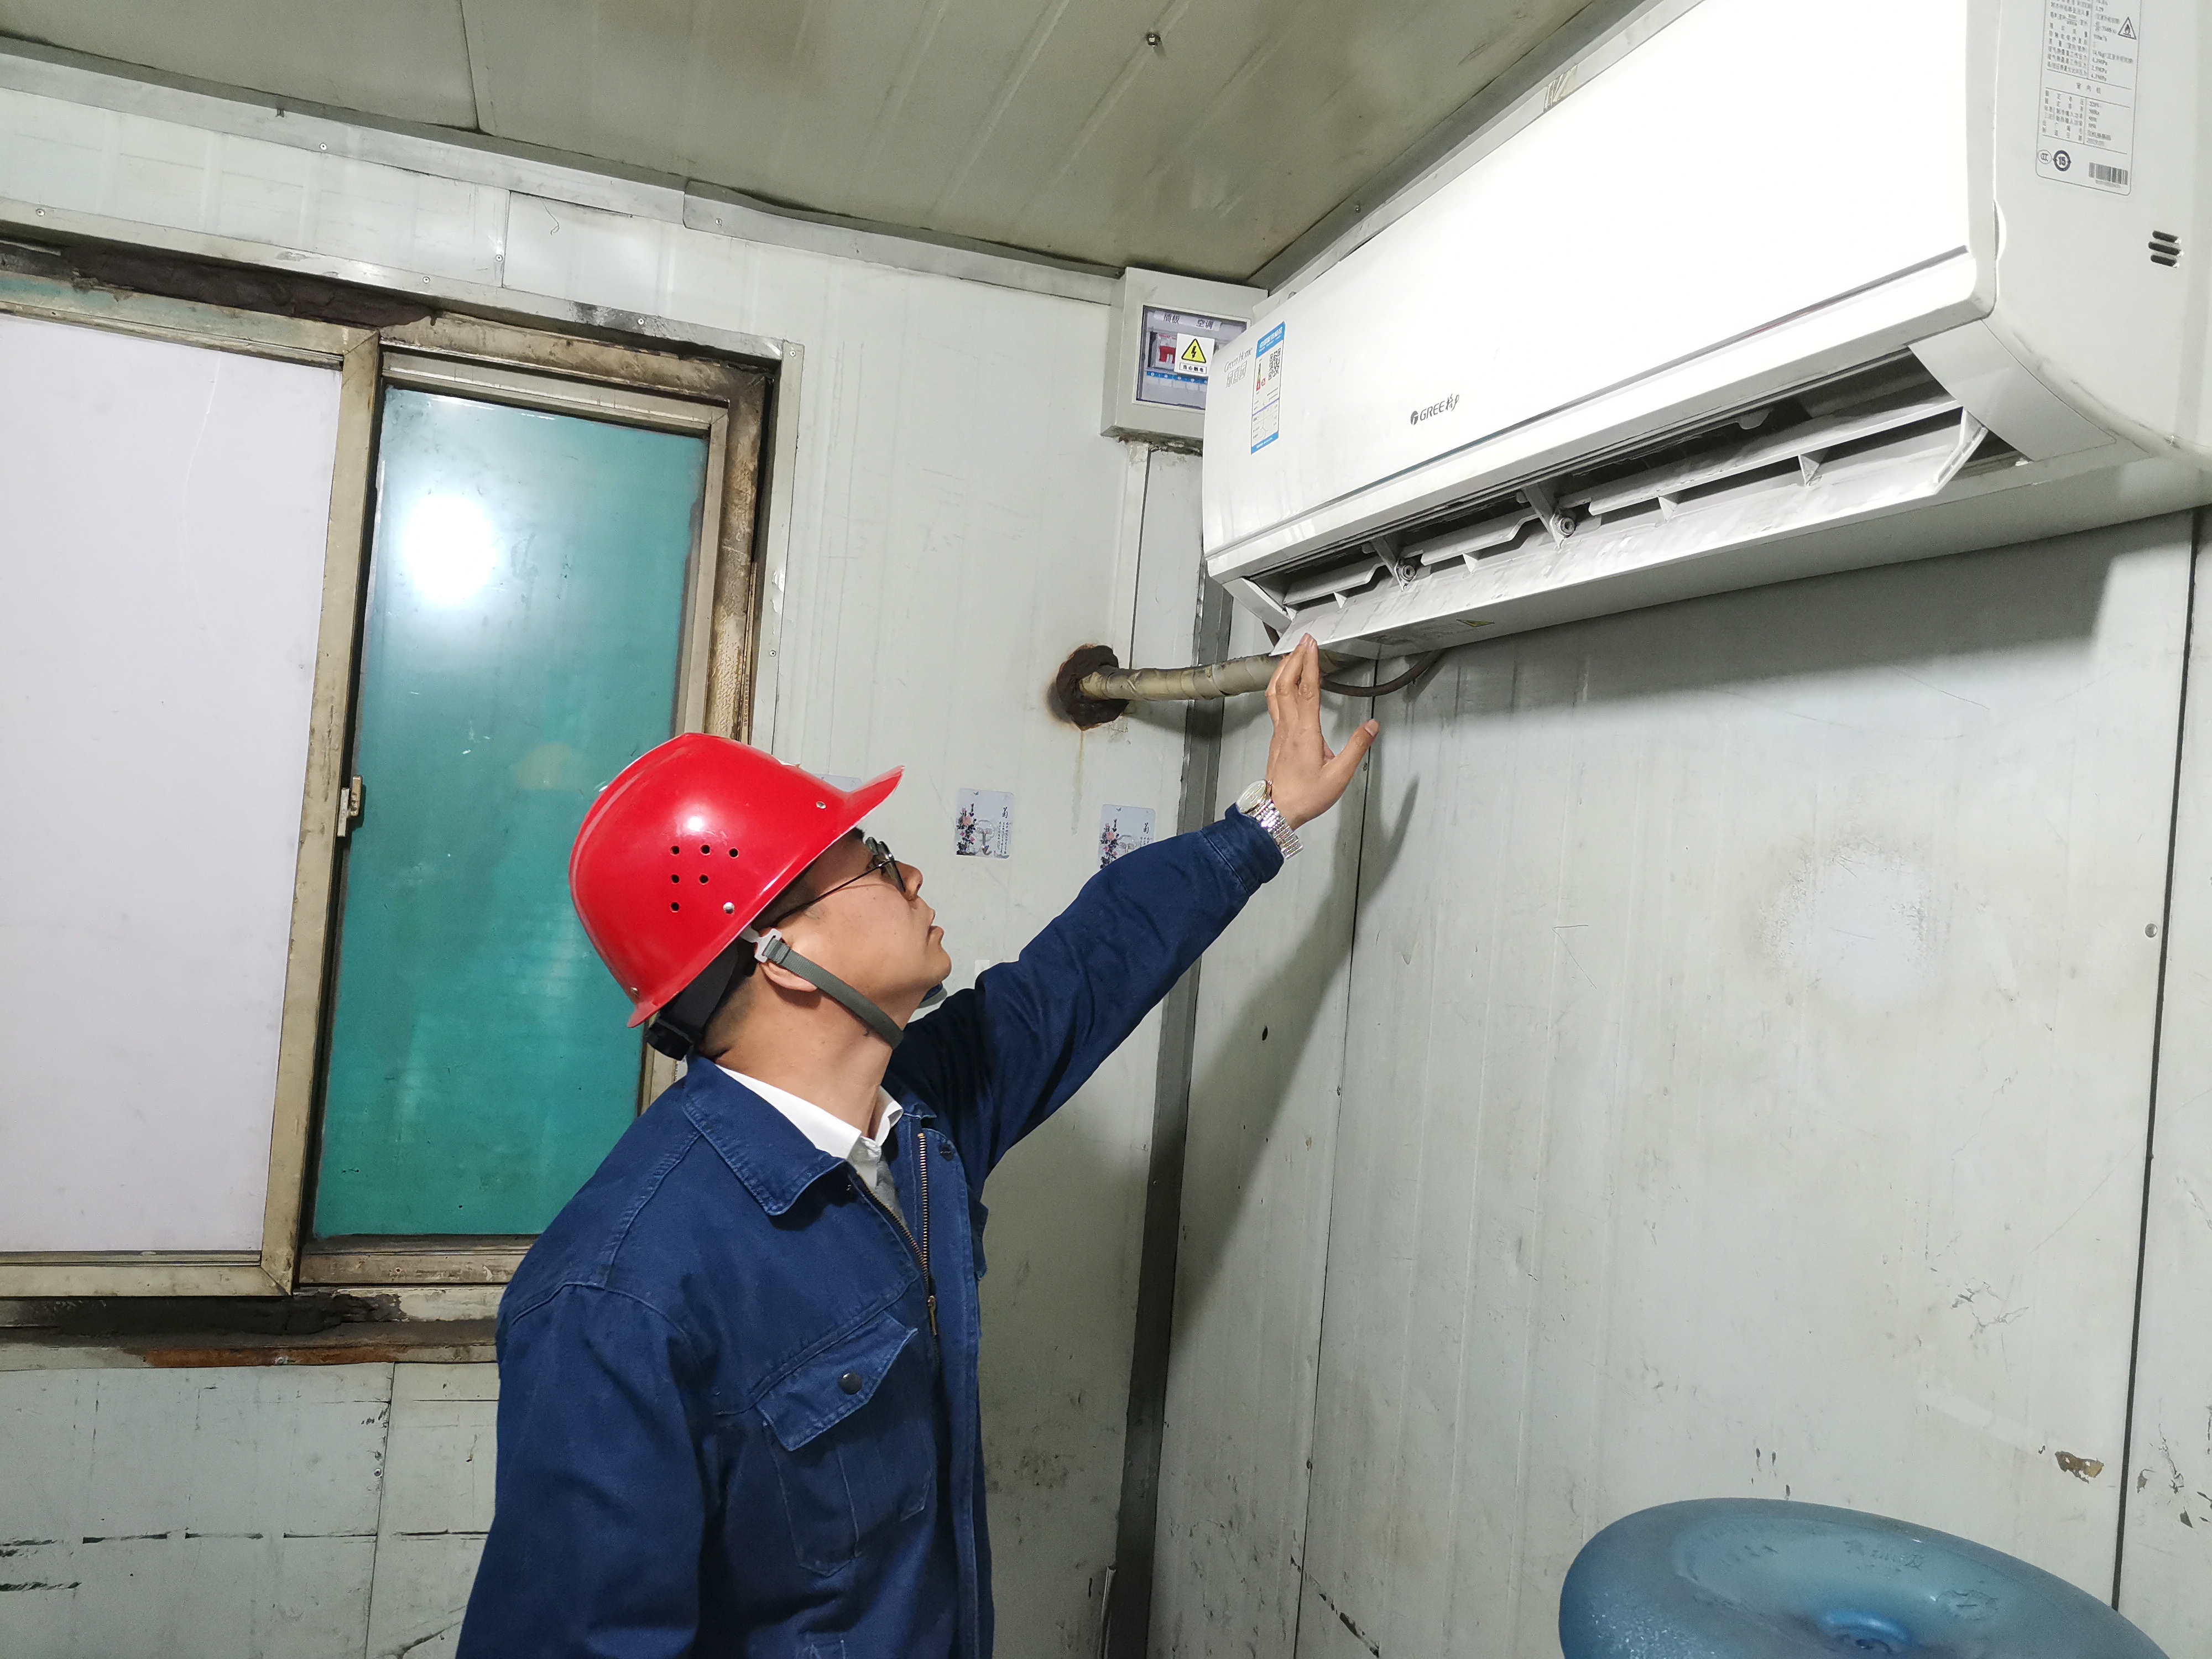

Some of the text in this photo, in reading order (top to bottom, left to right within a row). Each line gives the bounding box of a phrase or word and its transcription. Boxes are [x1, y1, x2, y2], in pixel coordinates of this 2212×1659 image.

[1196, 319, 1214, 330] 空调
[1183, 364, 1204, 373] 当心触电
[1420, 400, 1446, 421] GREE
